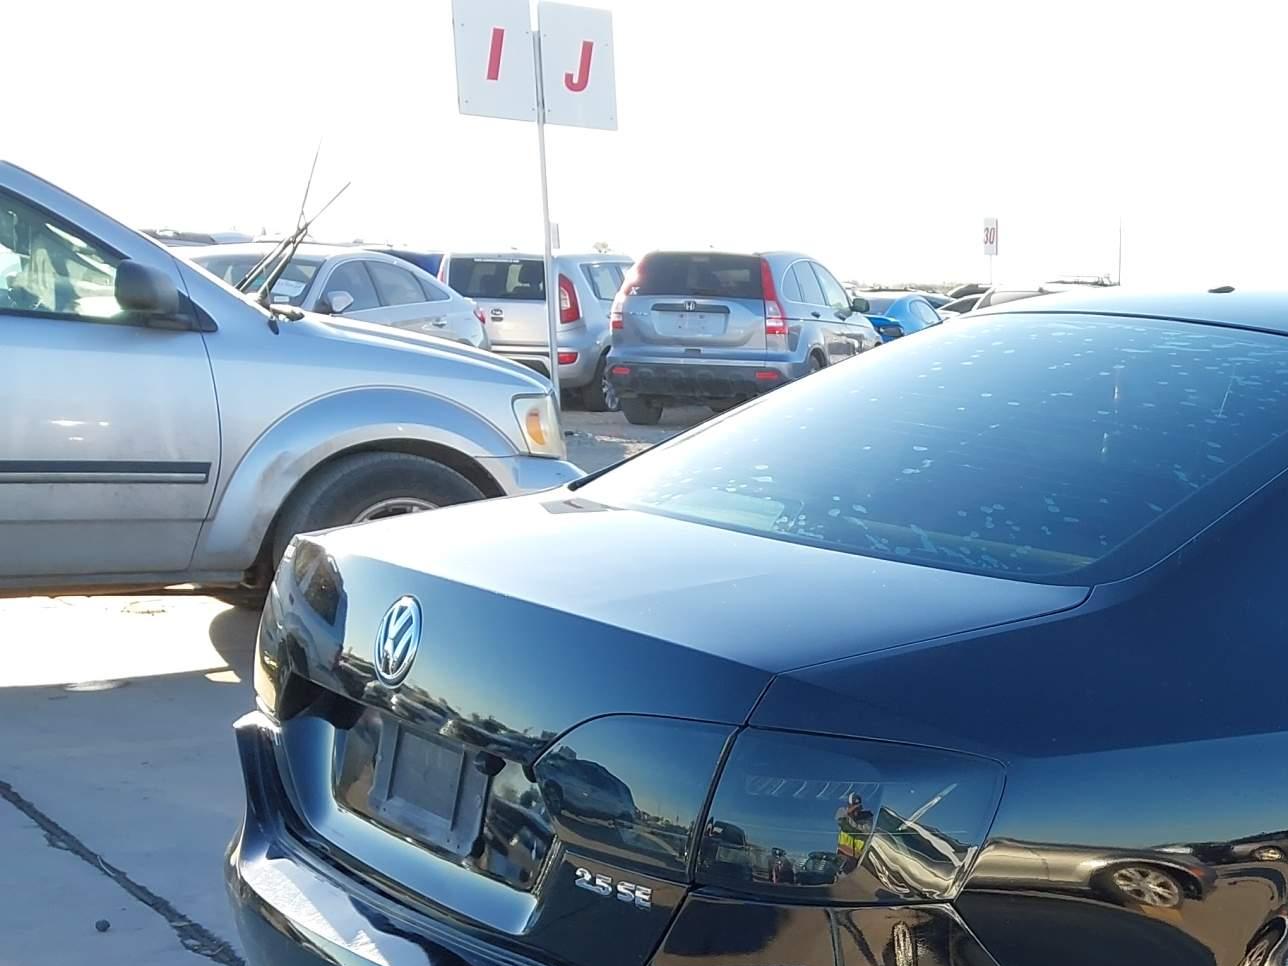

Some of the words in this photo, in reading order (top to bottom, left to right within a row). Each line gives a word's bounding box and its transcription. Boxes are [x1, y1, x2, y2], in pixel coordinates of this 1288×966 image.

[564, 40, 594, 92] J
[983, 227, 996, 245] 30
[617, 881, 652, 912] SE
